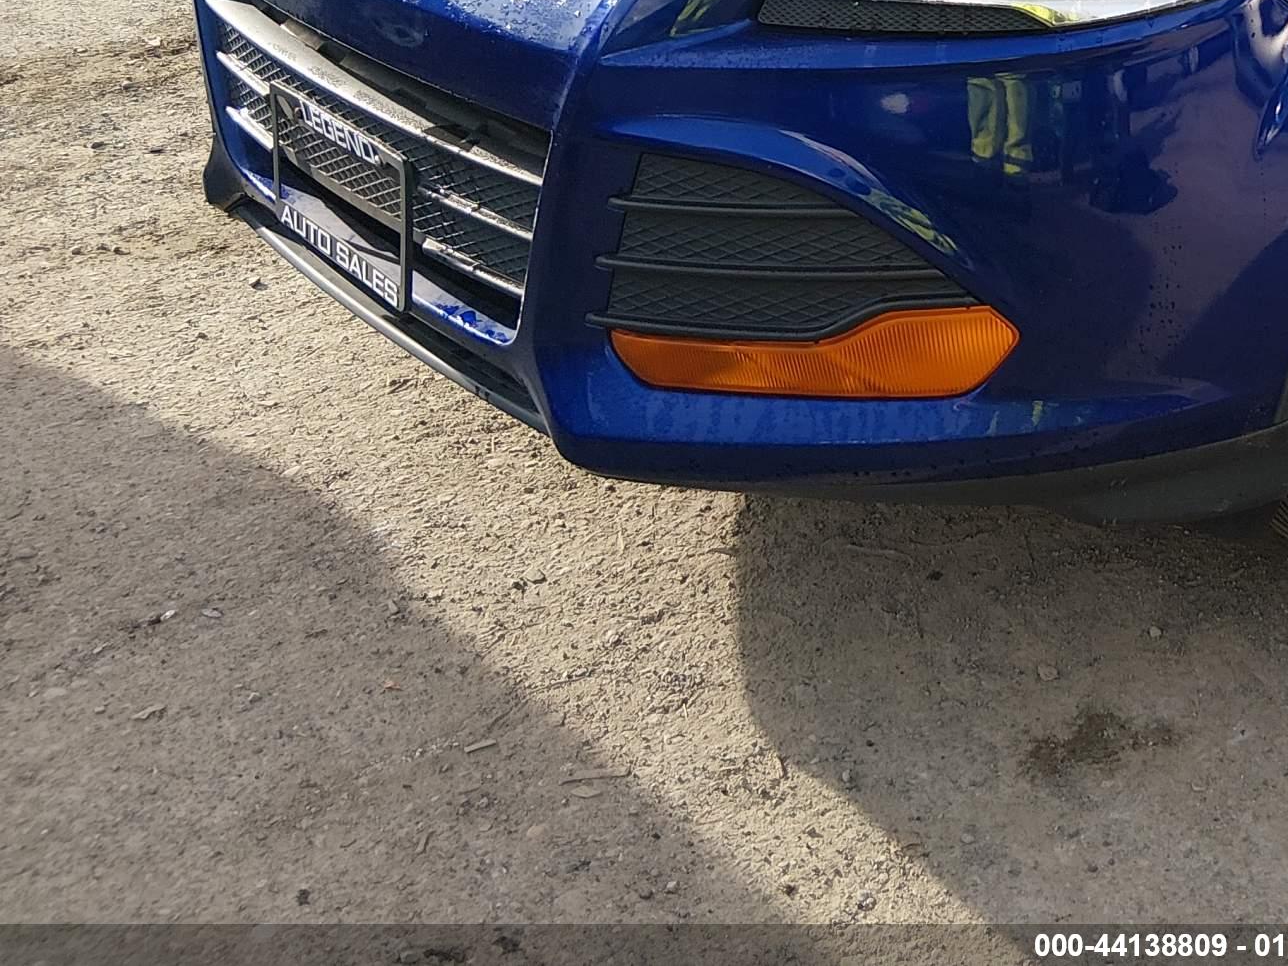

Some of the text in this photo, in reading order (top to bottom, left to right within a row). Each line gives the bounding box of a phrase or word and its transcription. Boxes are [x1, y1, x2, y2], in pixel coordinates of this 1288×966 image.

[300, 99, 376, 165] LEGEND
[280, 205, 399, 308] AUTO SALES
